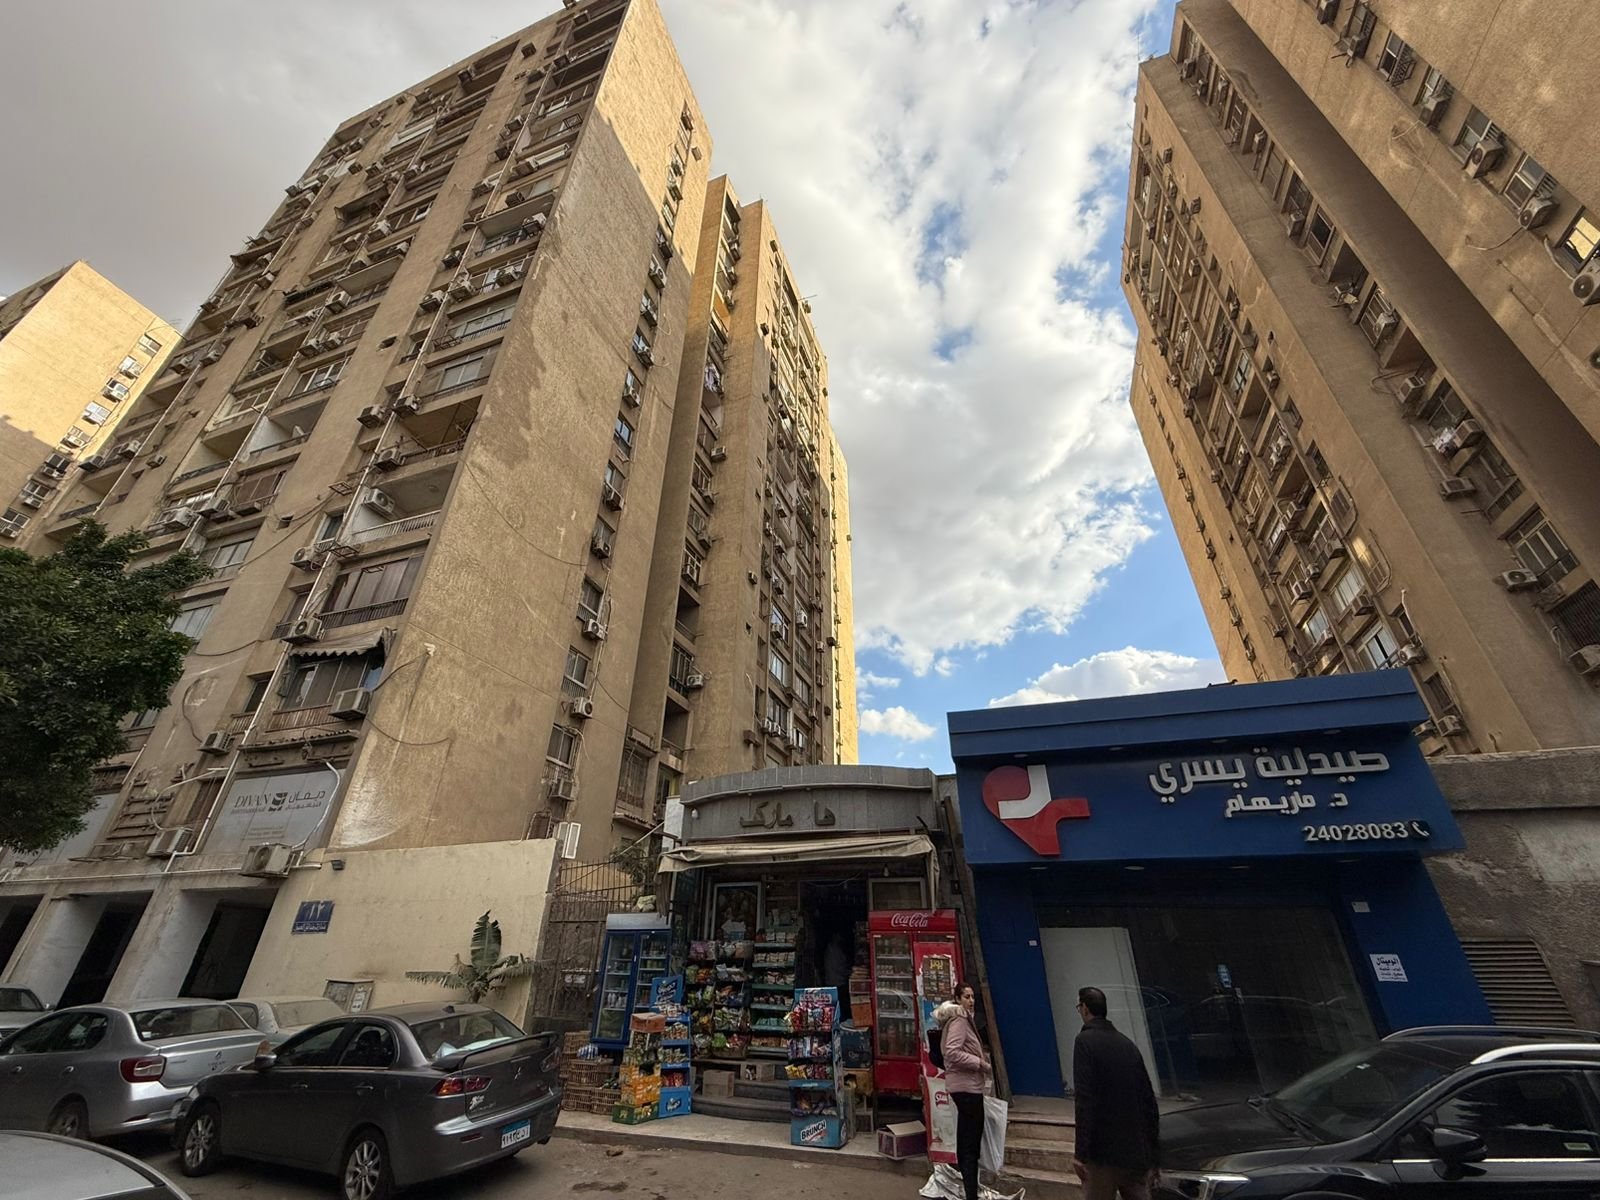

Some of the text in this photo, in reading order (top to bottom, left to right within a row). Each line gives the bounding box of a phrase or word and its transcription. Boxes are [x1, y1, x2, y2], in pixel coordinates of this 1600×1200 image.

[1150, 747, 1391, 803] صيدلية يسري
[1224, 790, 1317, 818] ماريهام
[1303, 822, 1409, 842] 24028083
[801, 1120, 826, 1140] BRUNCH
